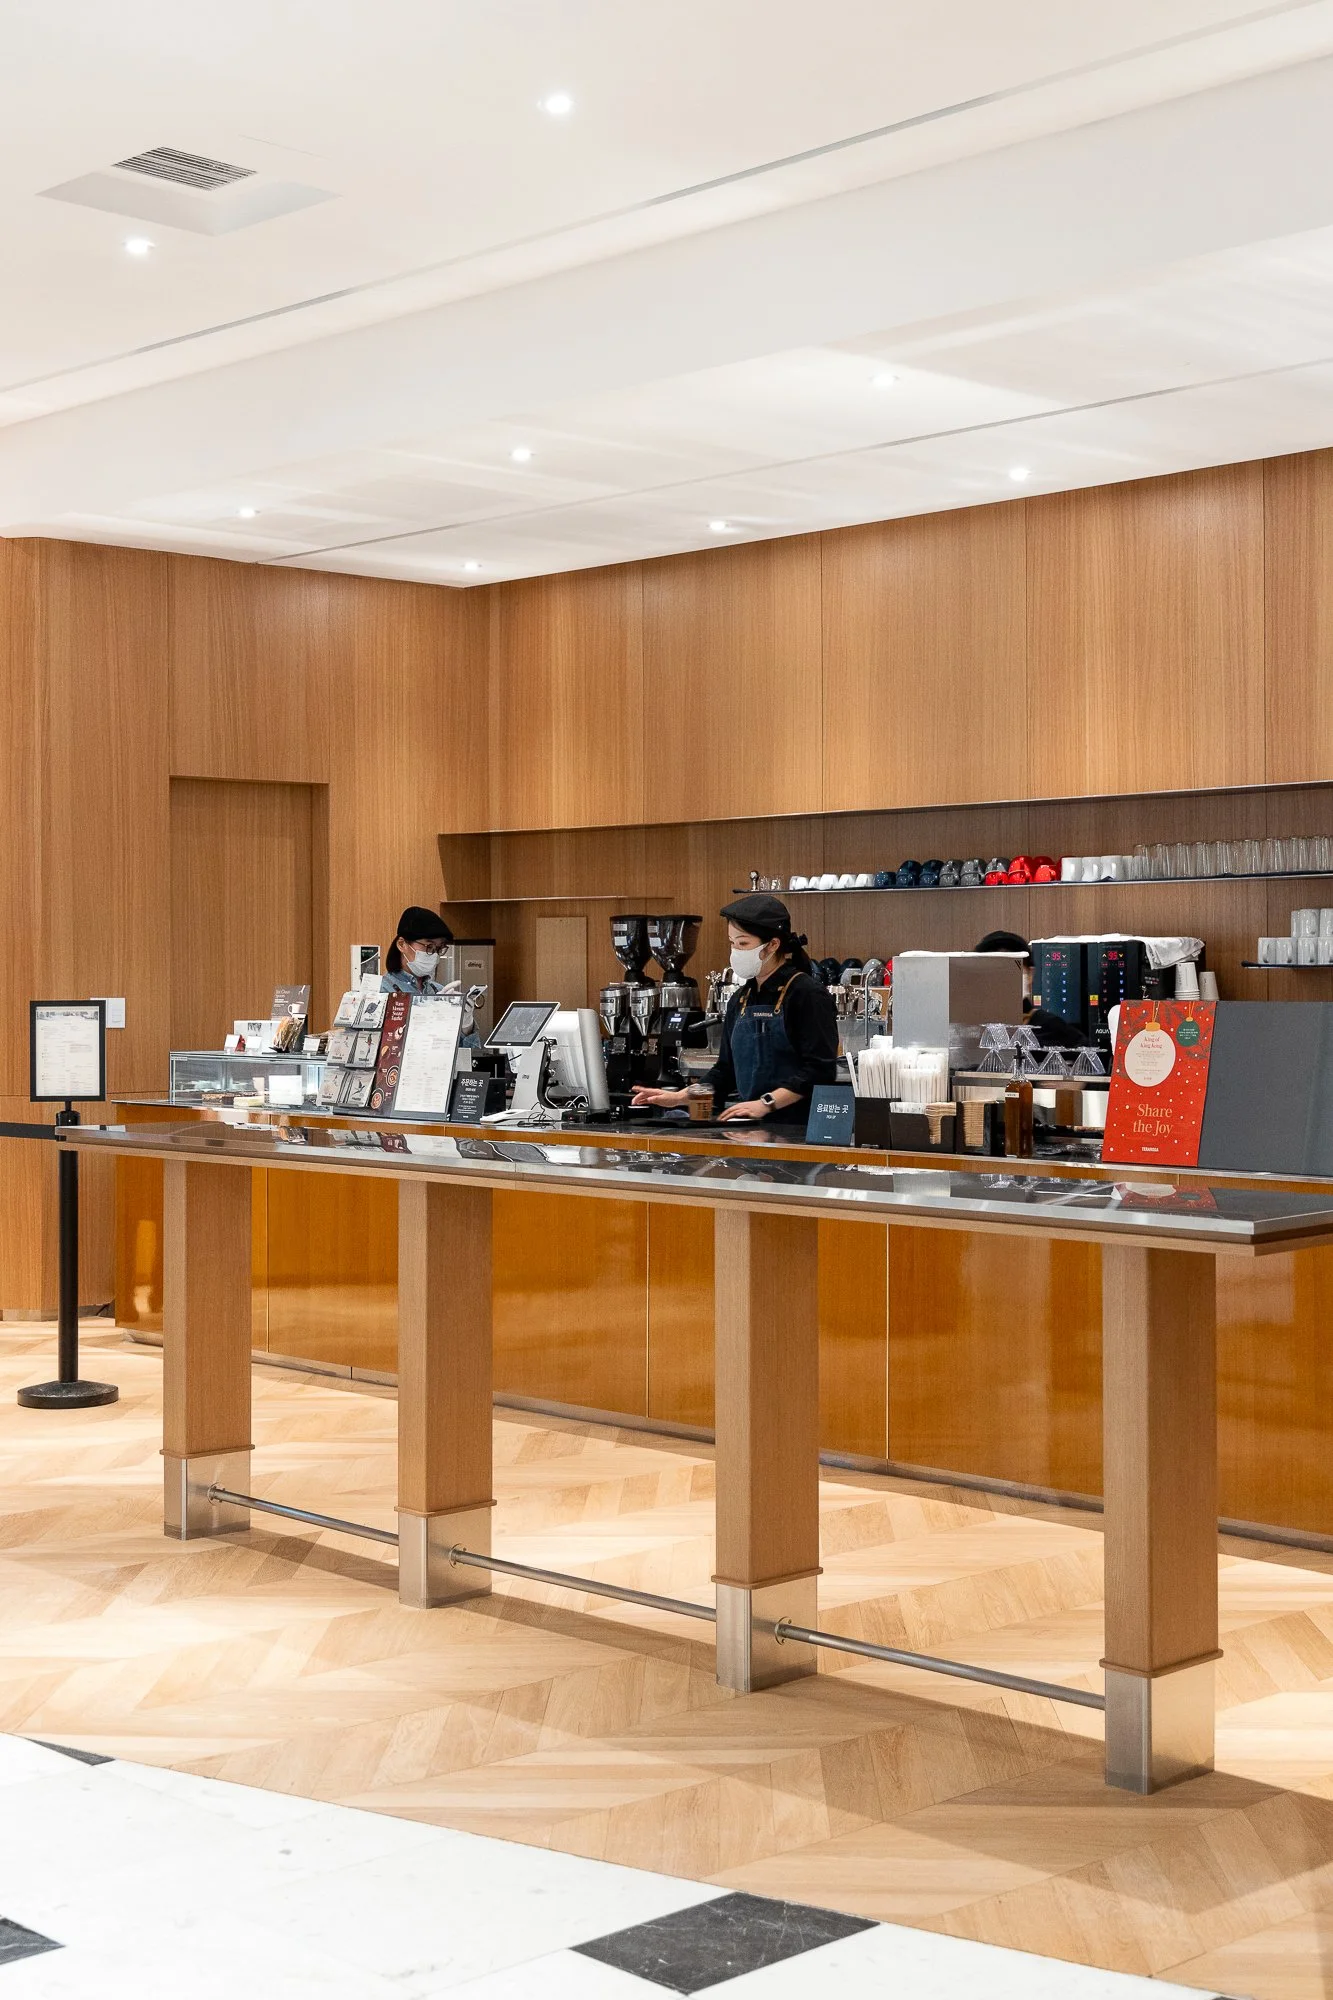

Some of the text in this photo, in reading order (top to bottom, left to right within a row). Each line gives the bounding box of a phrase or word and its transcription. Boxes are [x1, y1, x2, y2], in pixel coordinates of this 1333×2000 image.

[1052, 952, 1061, 960] 95
[817, 1103, 849, 1114] 음료받는 곳
[1137, 1104, 1172, 1118] Share
[1133, 1120, 1173, 1138] the Joy
